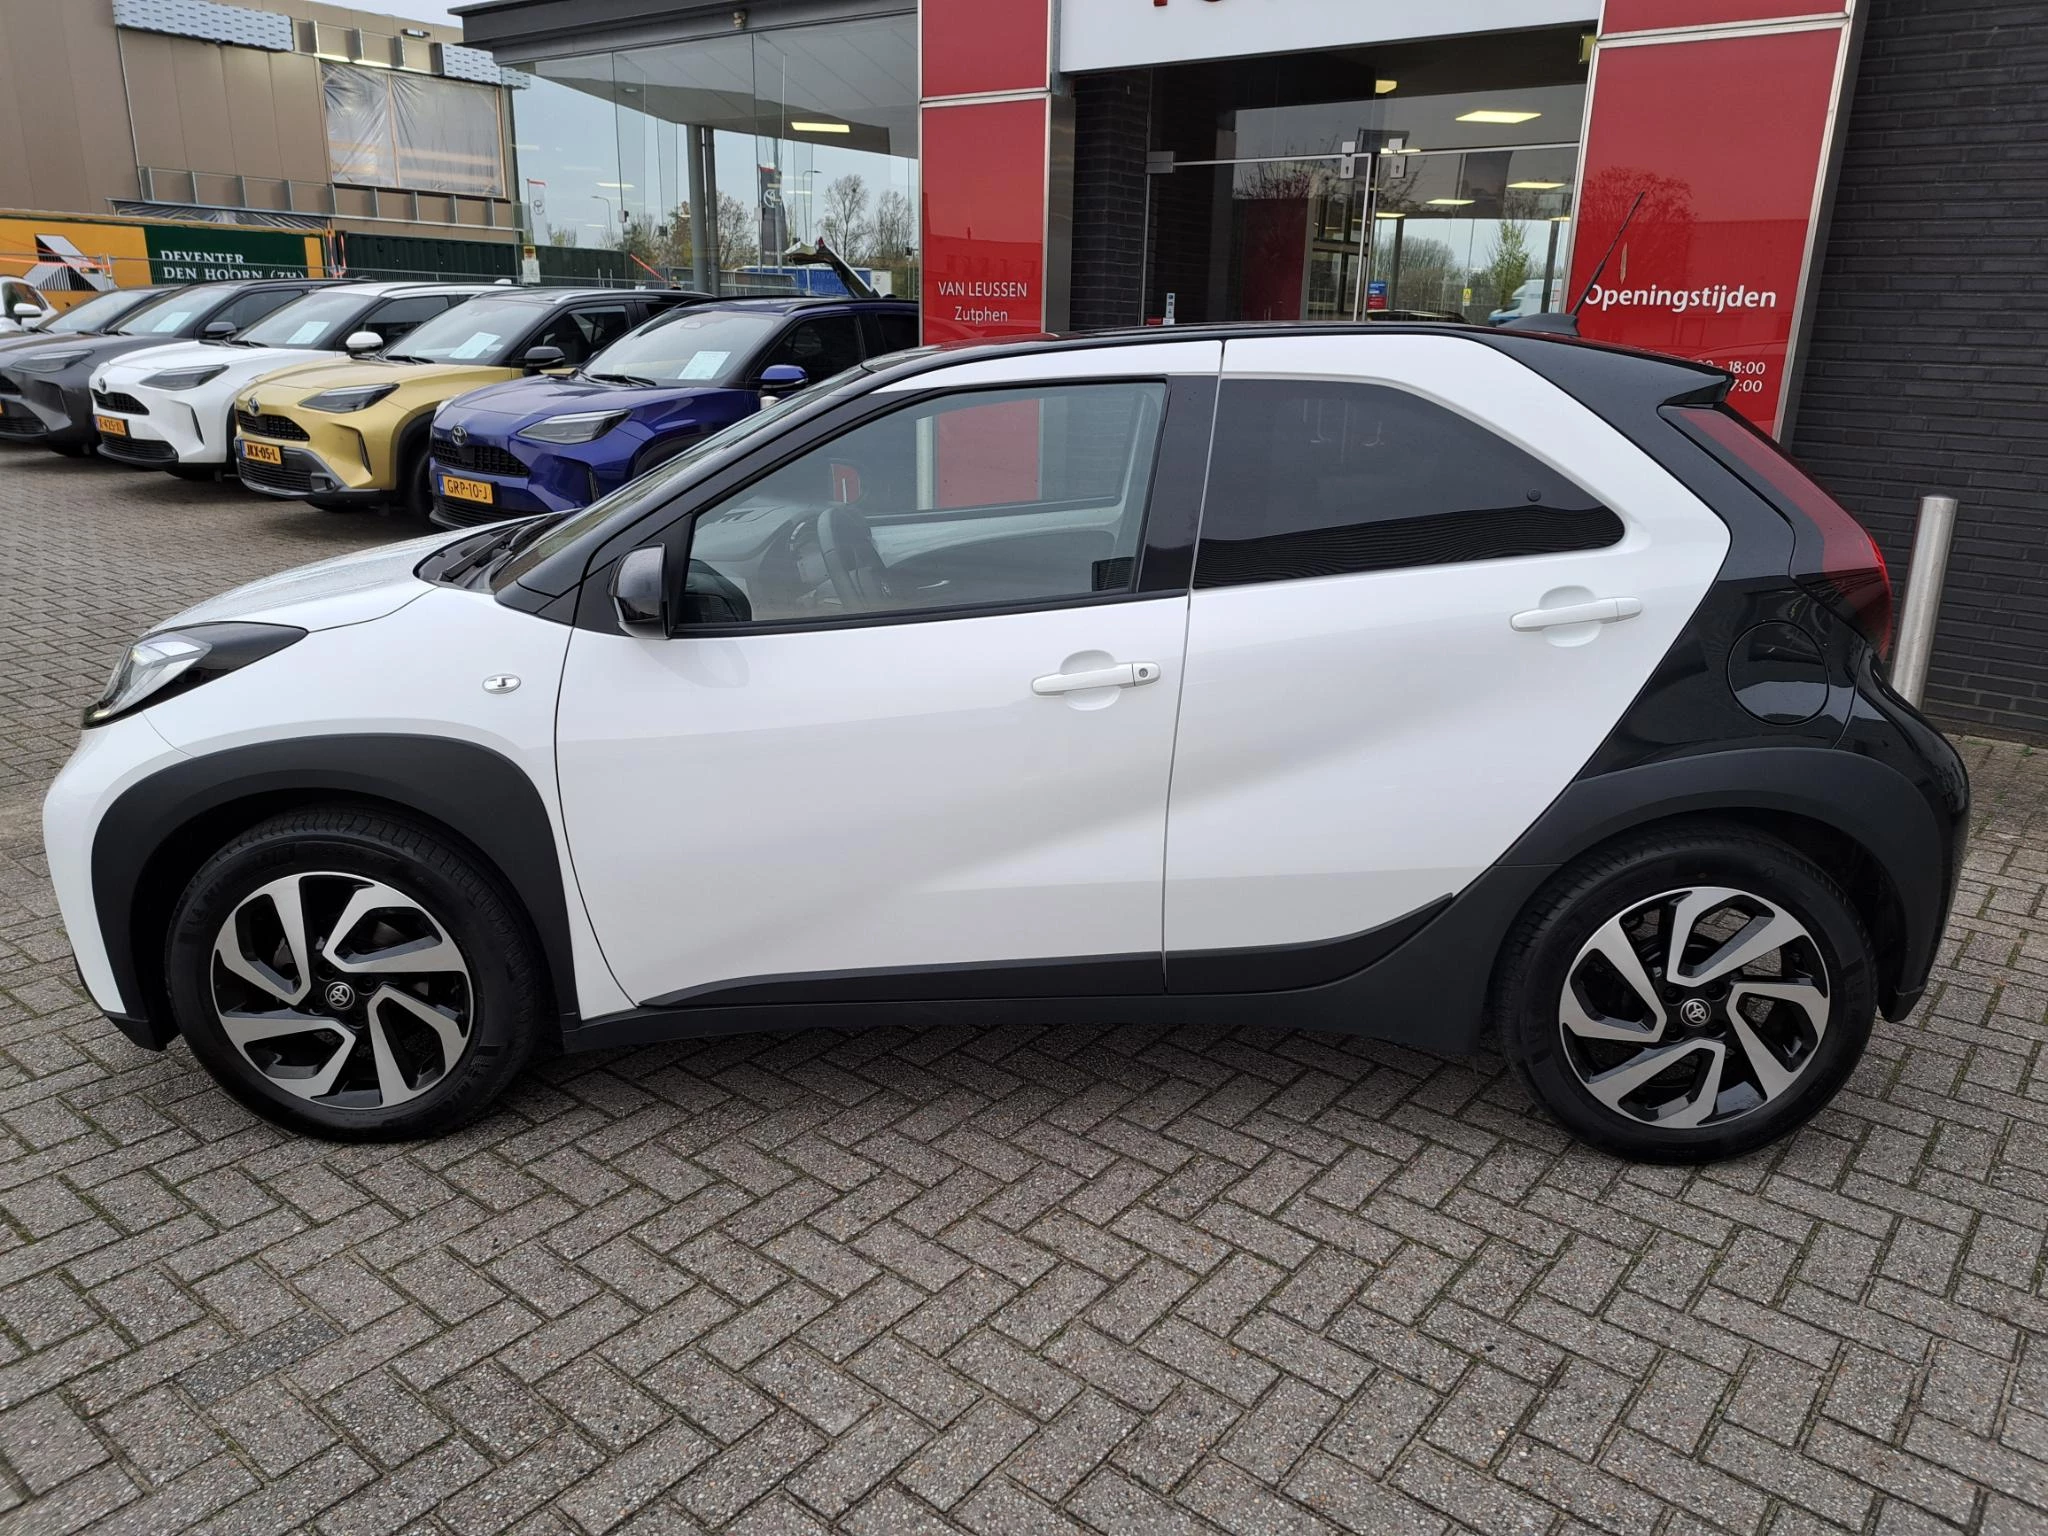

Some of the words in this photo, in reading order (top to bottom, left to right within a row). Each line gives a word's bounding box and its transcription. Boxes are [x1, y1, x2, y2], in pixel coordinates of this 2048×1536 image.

[160, 249, 245, 264] DEVENTER
[163, 266, 197, 279] DEN
[205, 267, 263, 280] HOORN
[938, 281, 965, 297] VAN
[968, 281, 1028, 298] LEUSSEN
[1585, 284, 1777, 314] Openingstijden
[954, 305, 1008, 325] Zutphen
[1728, 360, 1766, 375] 18:00
[446, 479, 488, 500] GRP-10-J
